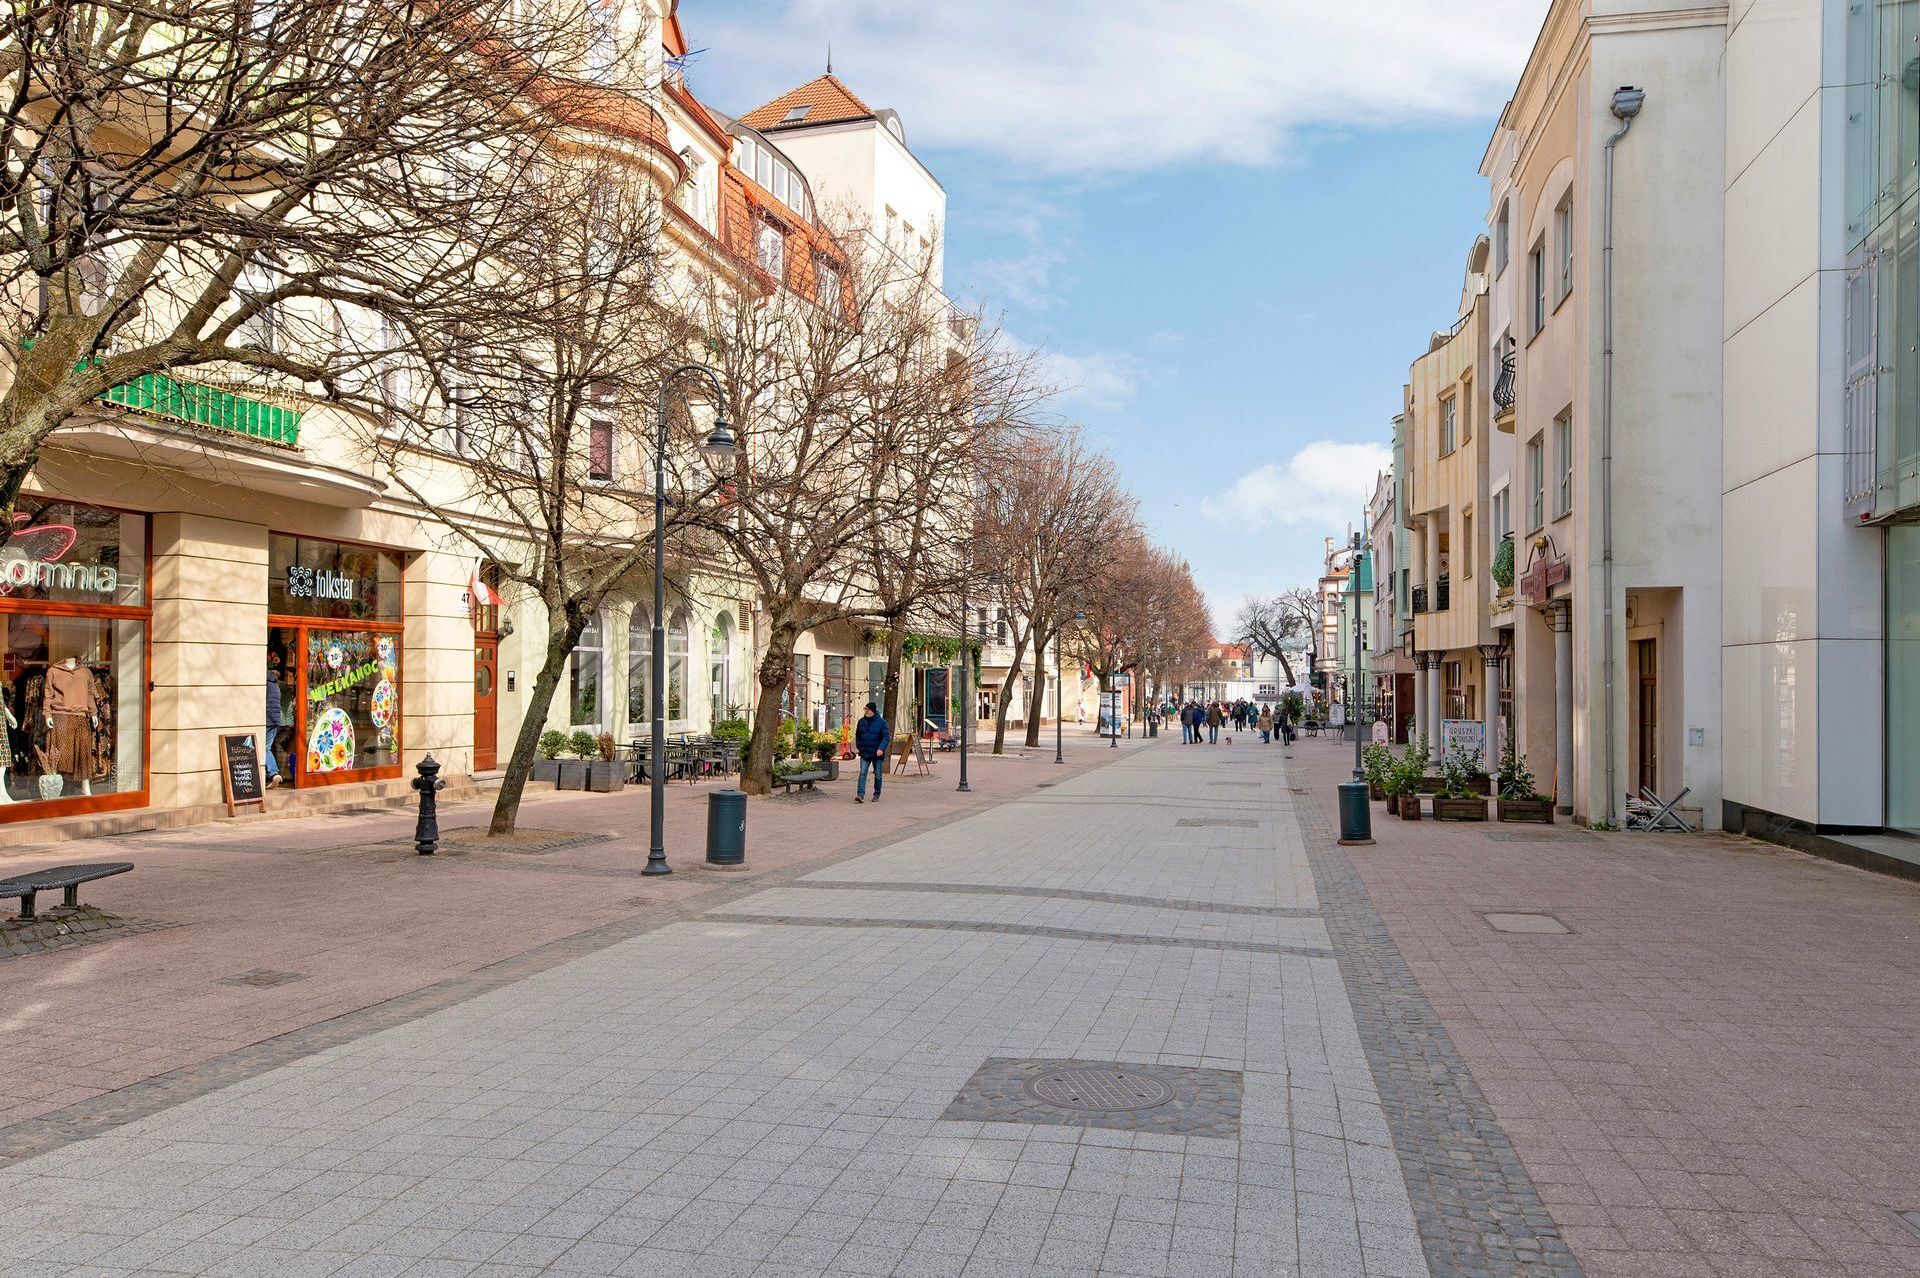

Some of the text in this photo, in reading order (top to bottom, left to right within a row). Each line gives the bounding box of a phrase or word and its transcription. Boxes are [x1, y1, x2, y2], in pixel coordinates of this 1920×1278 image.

[0, 558, 117, 592] omnia
[316, 569, 354, 600] folkstar
[461, 592, 471, 604] 47
[310, 659, 379, 702] WIELKANOC
